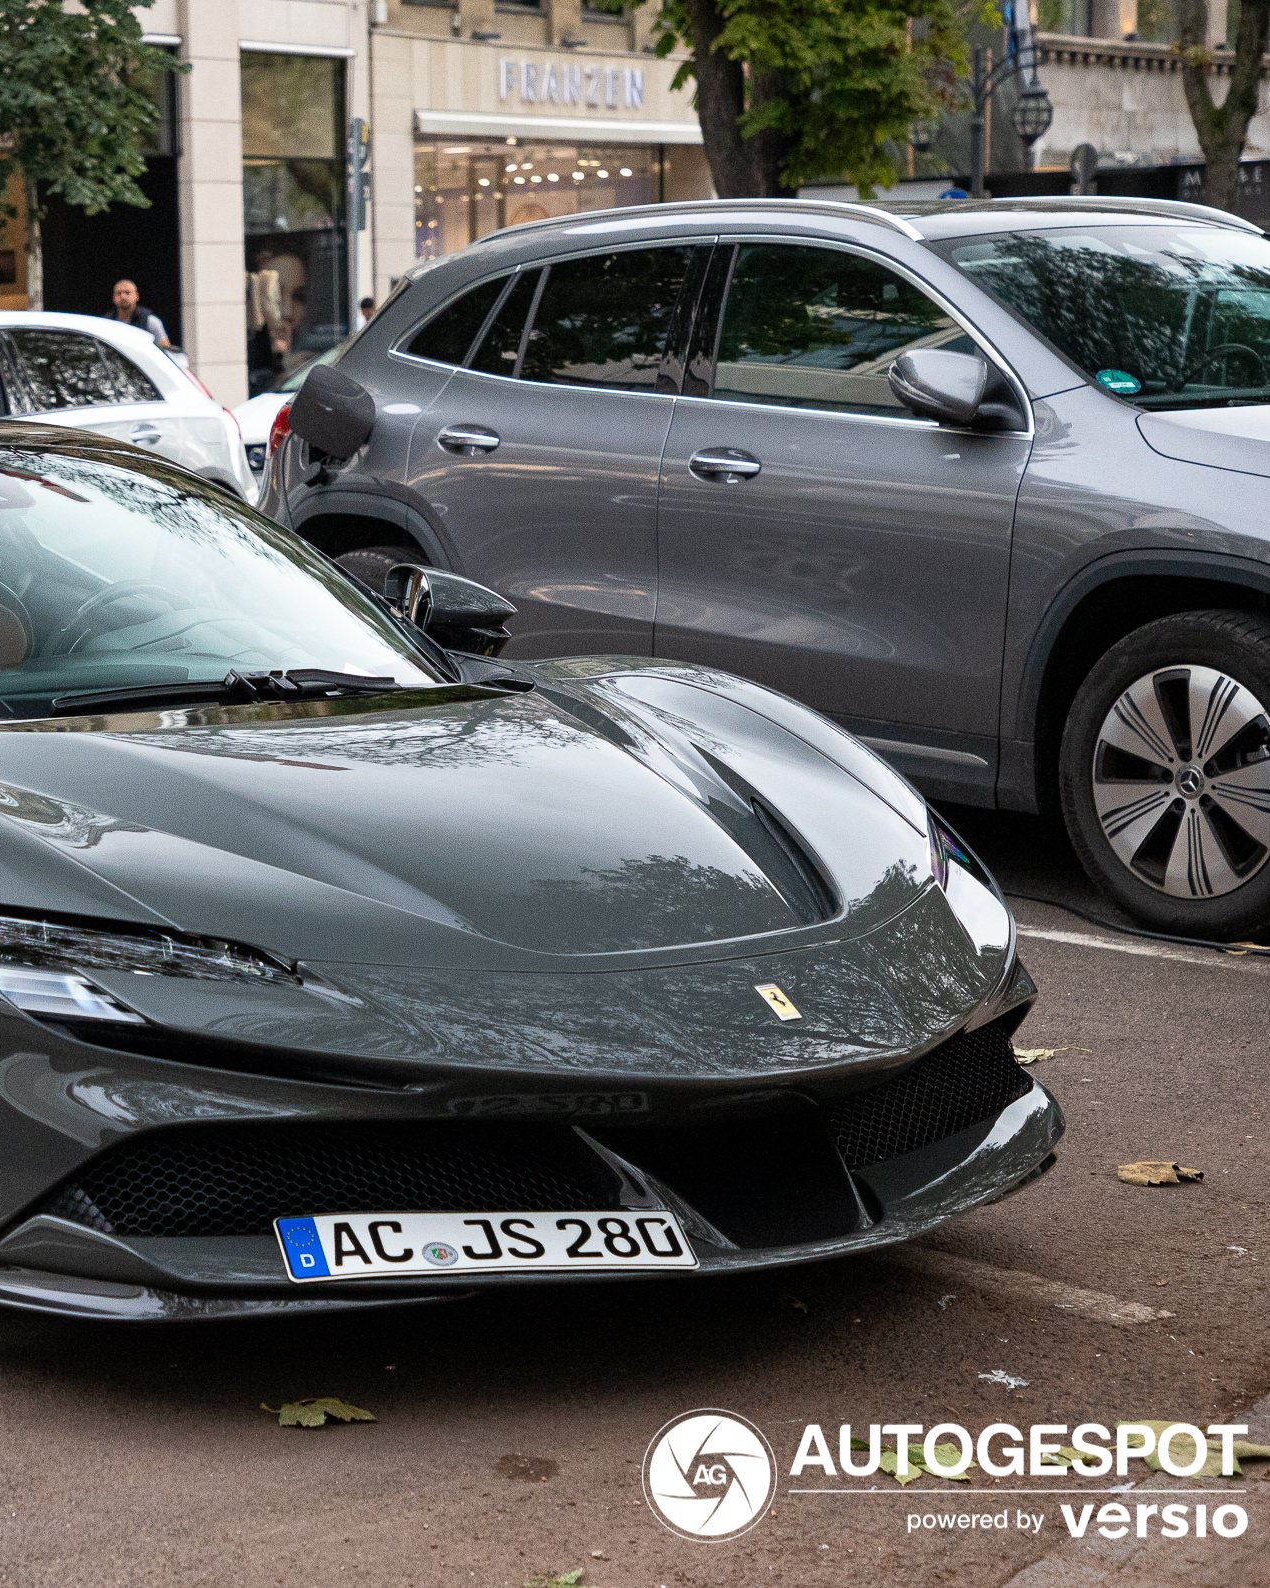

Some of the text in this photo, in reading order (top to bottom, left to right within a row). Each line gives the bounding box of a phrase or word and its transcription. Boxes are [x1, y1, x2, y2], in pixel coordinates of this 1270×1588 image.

[500, 60, 644, 105] FRANZEN
[299, 1253, 316, 1268] D
[333, 1221, 414, 1267] AC
[462, 1218, 546, 1261] JS
[555, 1217, 684, 1259] 280
